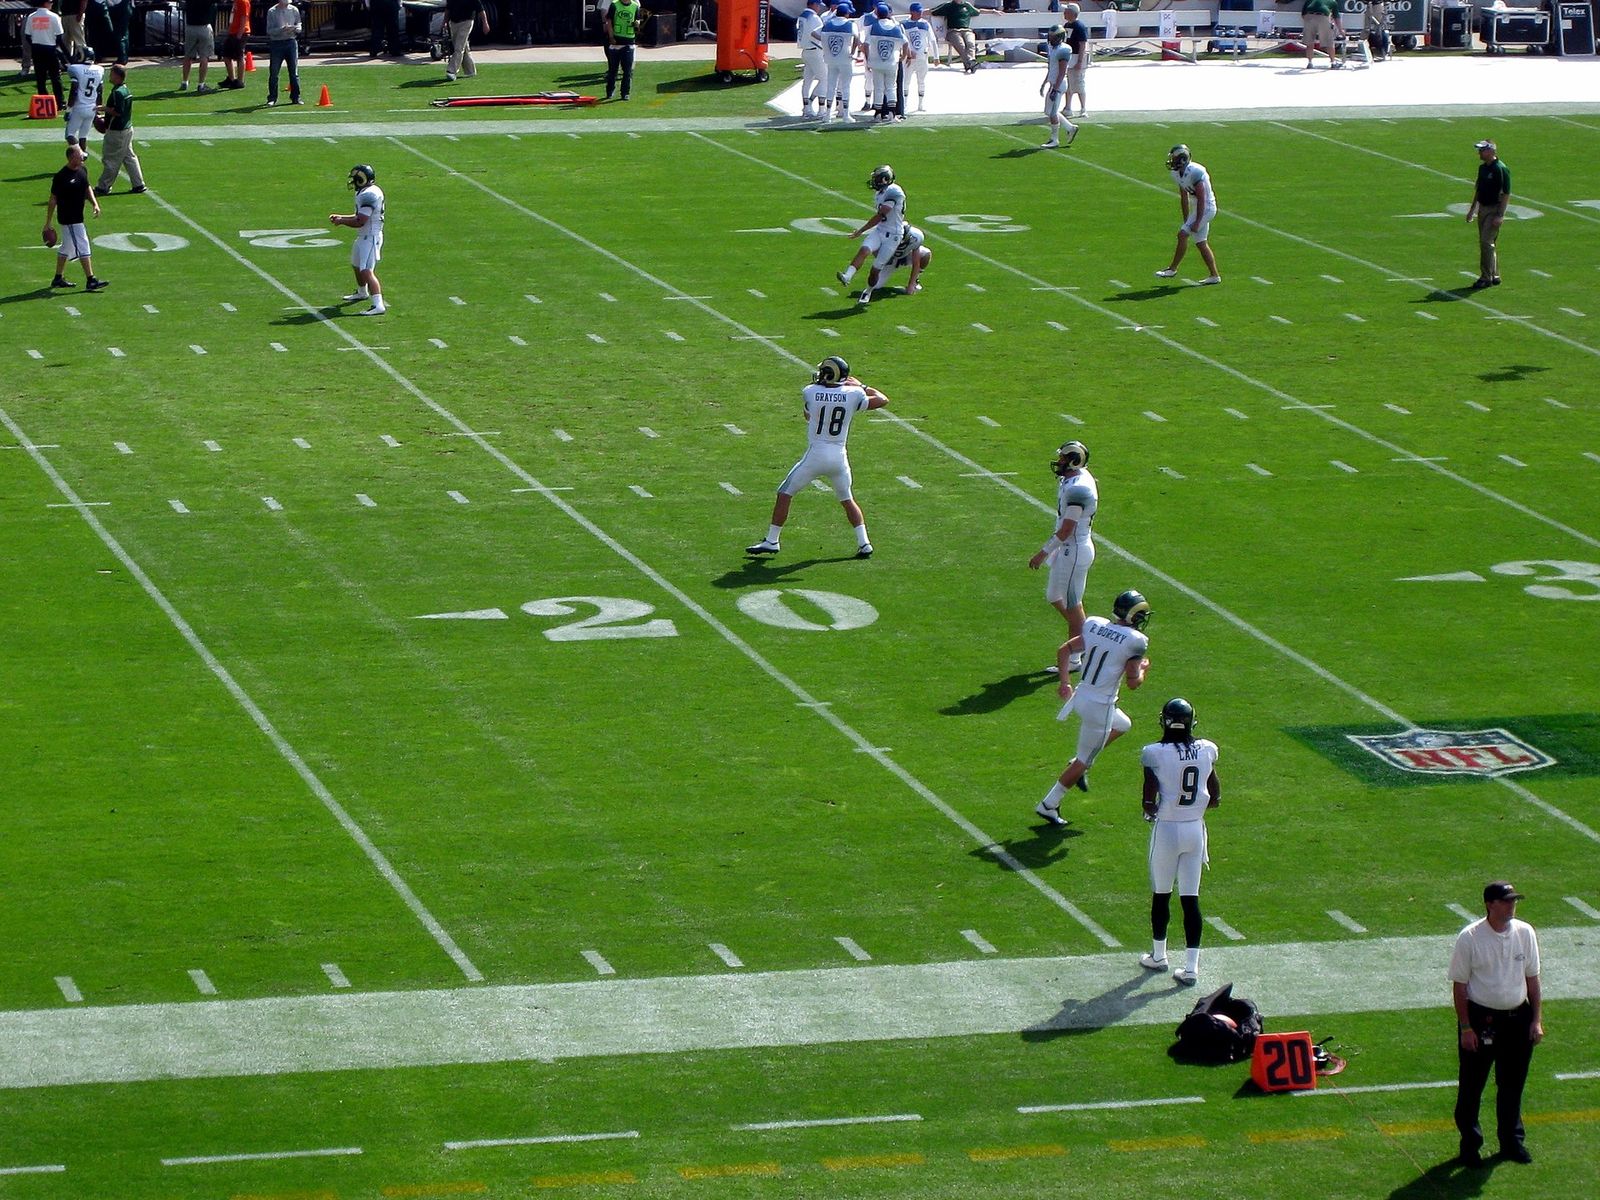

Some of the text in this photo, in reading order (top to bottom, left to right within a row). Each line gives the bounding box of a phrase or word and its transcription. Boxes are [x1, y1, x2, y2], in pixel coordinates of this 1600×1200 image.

[1563, 7, 1586, 15] Telex
[84, 78, 95, 97] 5
[35, 98, 55, 116] 20
[815, 392, 847, 402] GRAYSON
[816, 405, 846, 436] 18
[1097, 626, 1127, 644] BORCKY
[1082, 645, 1109, 686] 11
[1178, 749, 1199, 761] LAW
[1396, 746, 1533, 768] NFL
[1178, 766, 1200, 806] 9
[1263, 1039, 1312, 1087] 20
